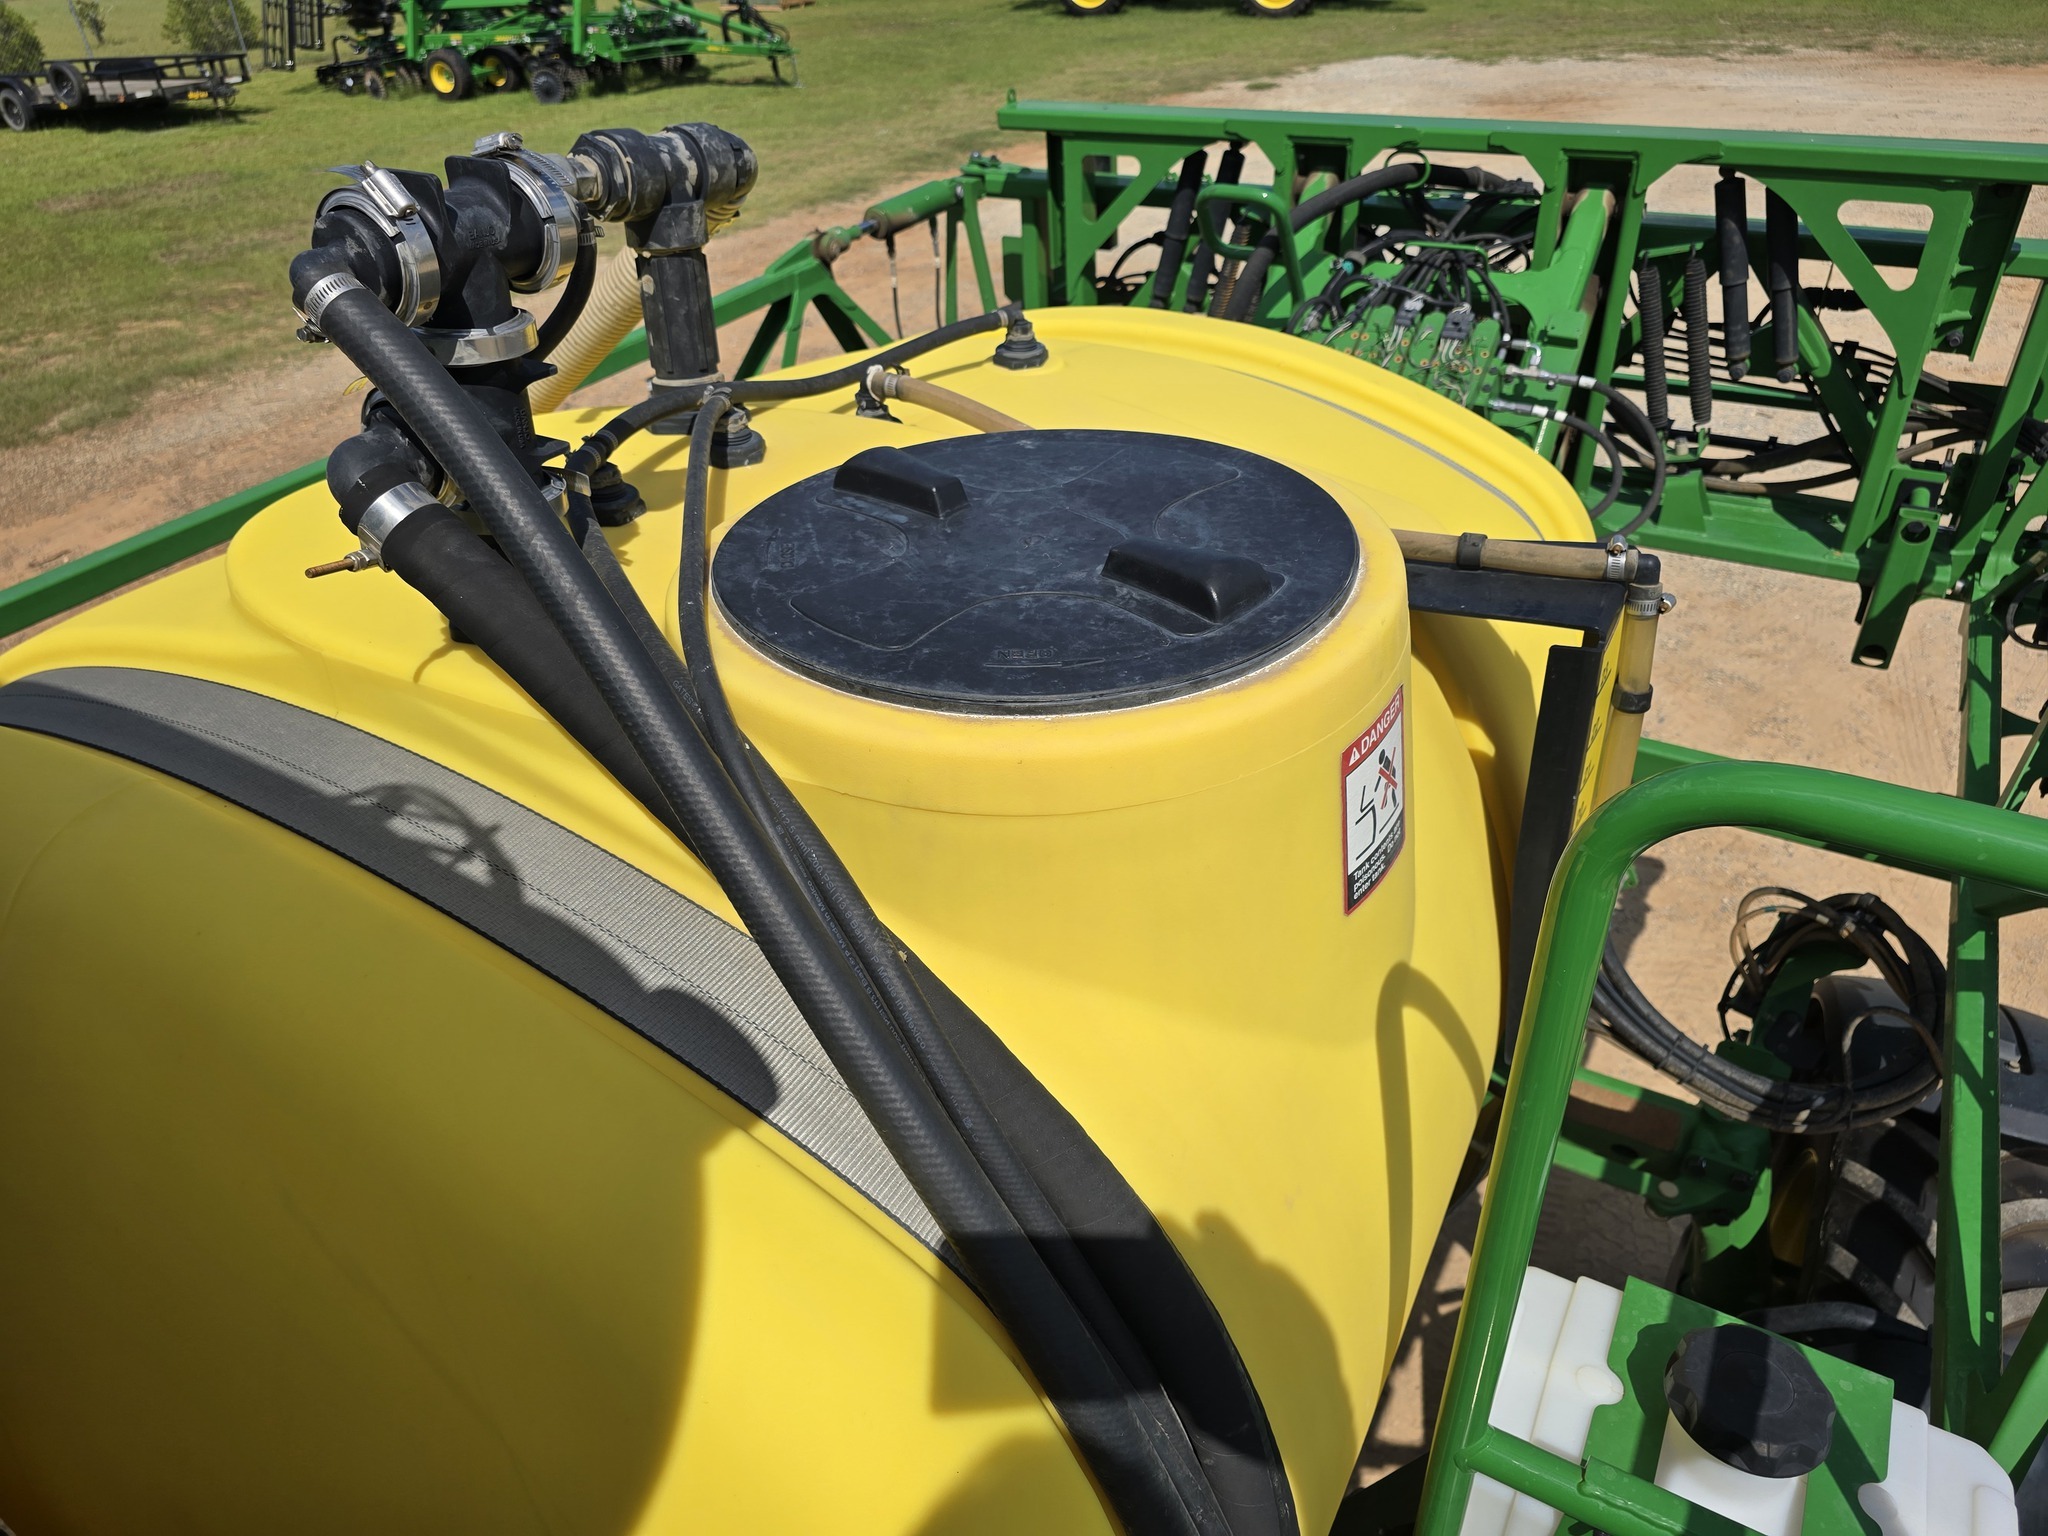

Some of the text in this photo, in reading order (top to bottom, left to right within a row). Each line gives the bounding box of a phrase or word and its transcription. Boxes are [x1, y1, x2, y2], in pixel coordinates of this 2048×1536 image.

[997, 648, 1054, 660] OPEN
[1361, 694, 1400, 755] DANGER
[1353, 861, 1370, 881] Tank
[1370, 832, 1394, 864] contents
[1387, 840, 1394, 853] Do
[807, 880, 826, 911] Mexico
[1353, 878, 1372, 900] enter
[823, 911, 831, 921] in
[829, 921, 847, 948] Made
[849, 919, 866, 943] Bar]
[877, 966, 897, 997] Made
[895, 998, 904, 1010] in
[902, 1010, 926, 1050] Mexico
